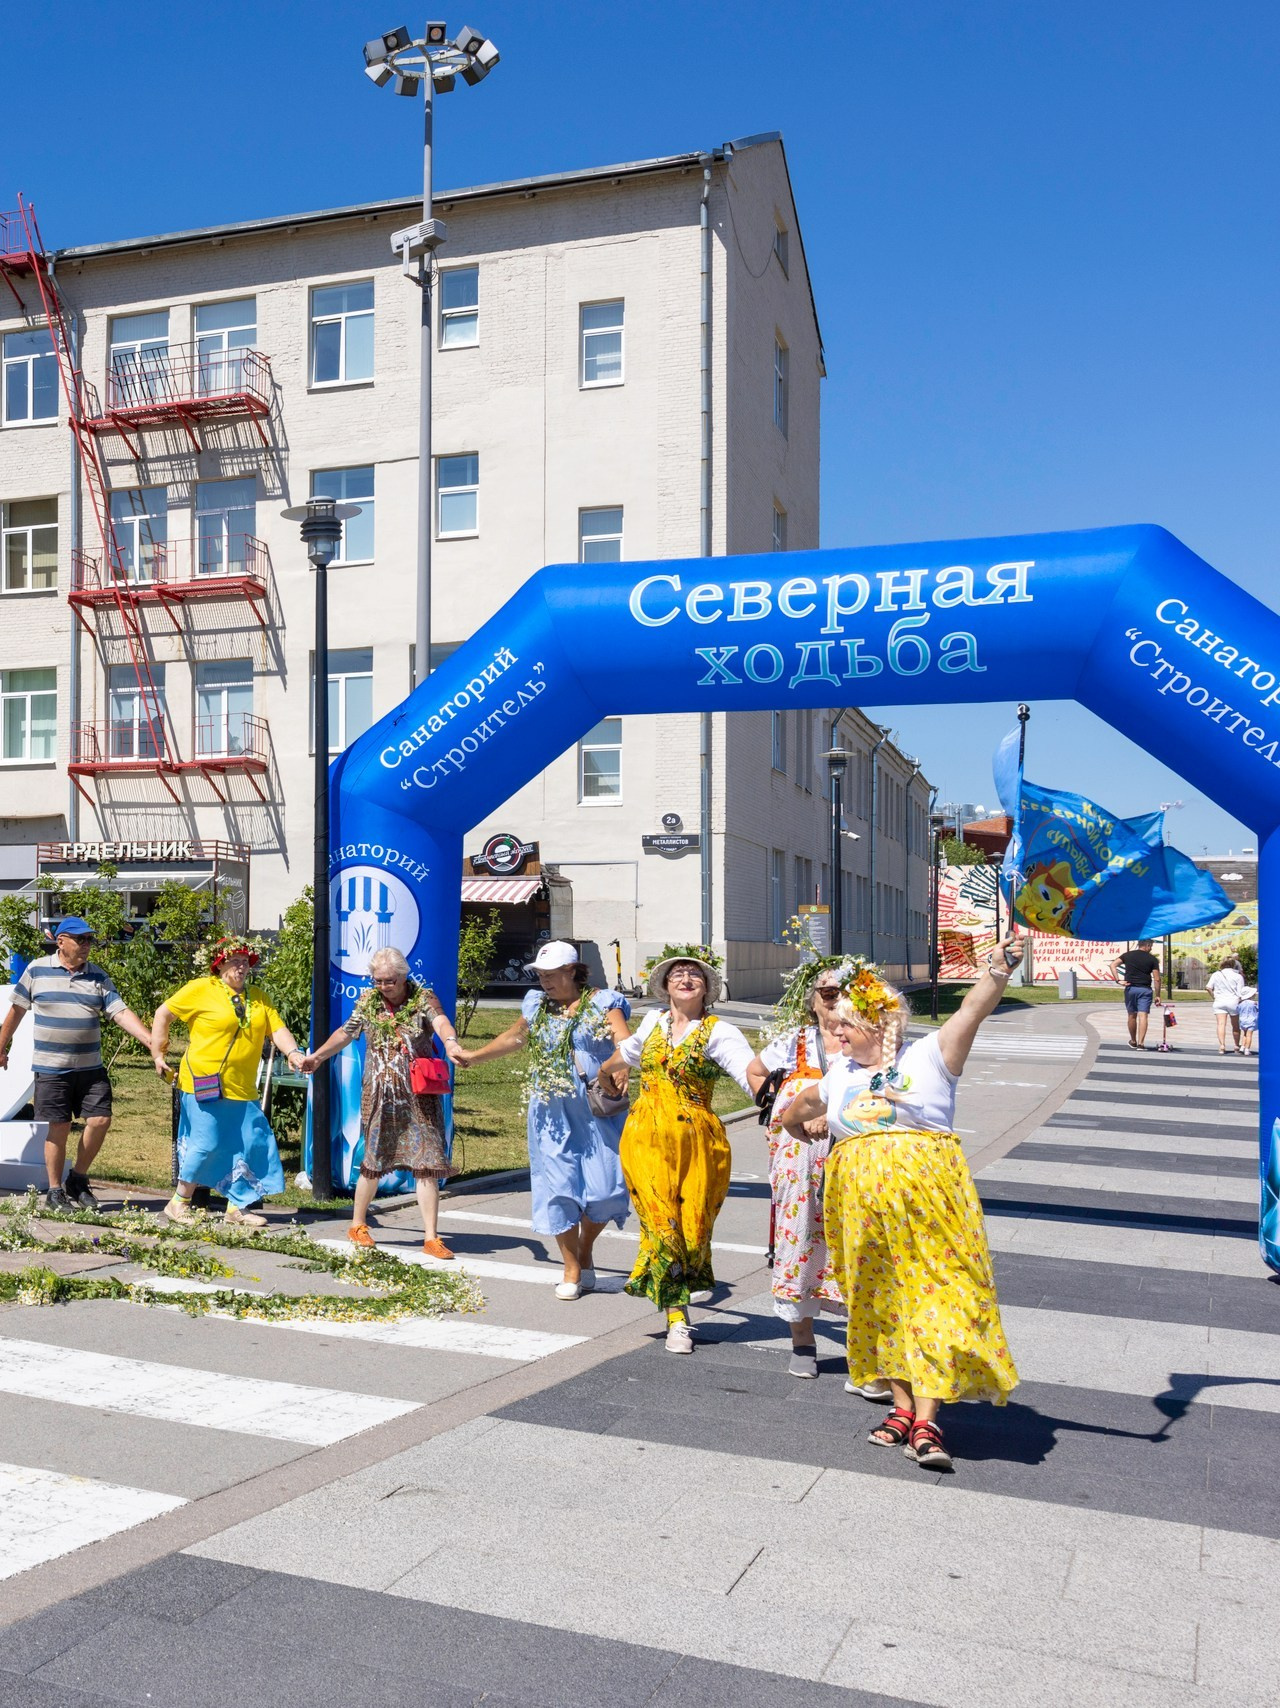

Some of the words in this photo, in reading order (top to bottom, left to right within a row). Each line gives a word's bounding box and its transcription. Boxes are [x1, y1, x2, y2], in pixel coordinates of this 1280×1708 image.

[629, 561, 1035, 634] Северная
[695, 612, 987, 689] ходьба
[379, 646, 519, 769] Санаторий
[400, 661, 547, 790] “Строитель”
[1125, 627, 1280, 769] “Строител
[58, 842, 193, 861] ТРДЕЛЬНИК
[666, 816, 676, 824] 2а
[329, 843, 430, 883] наторий
